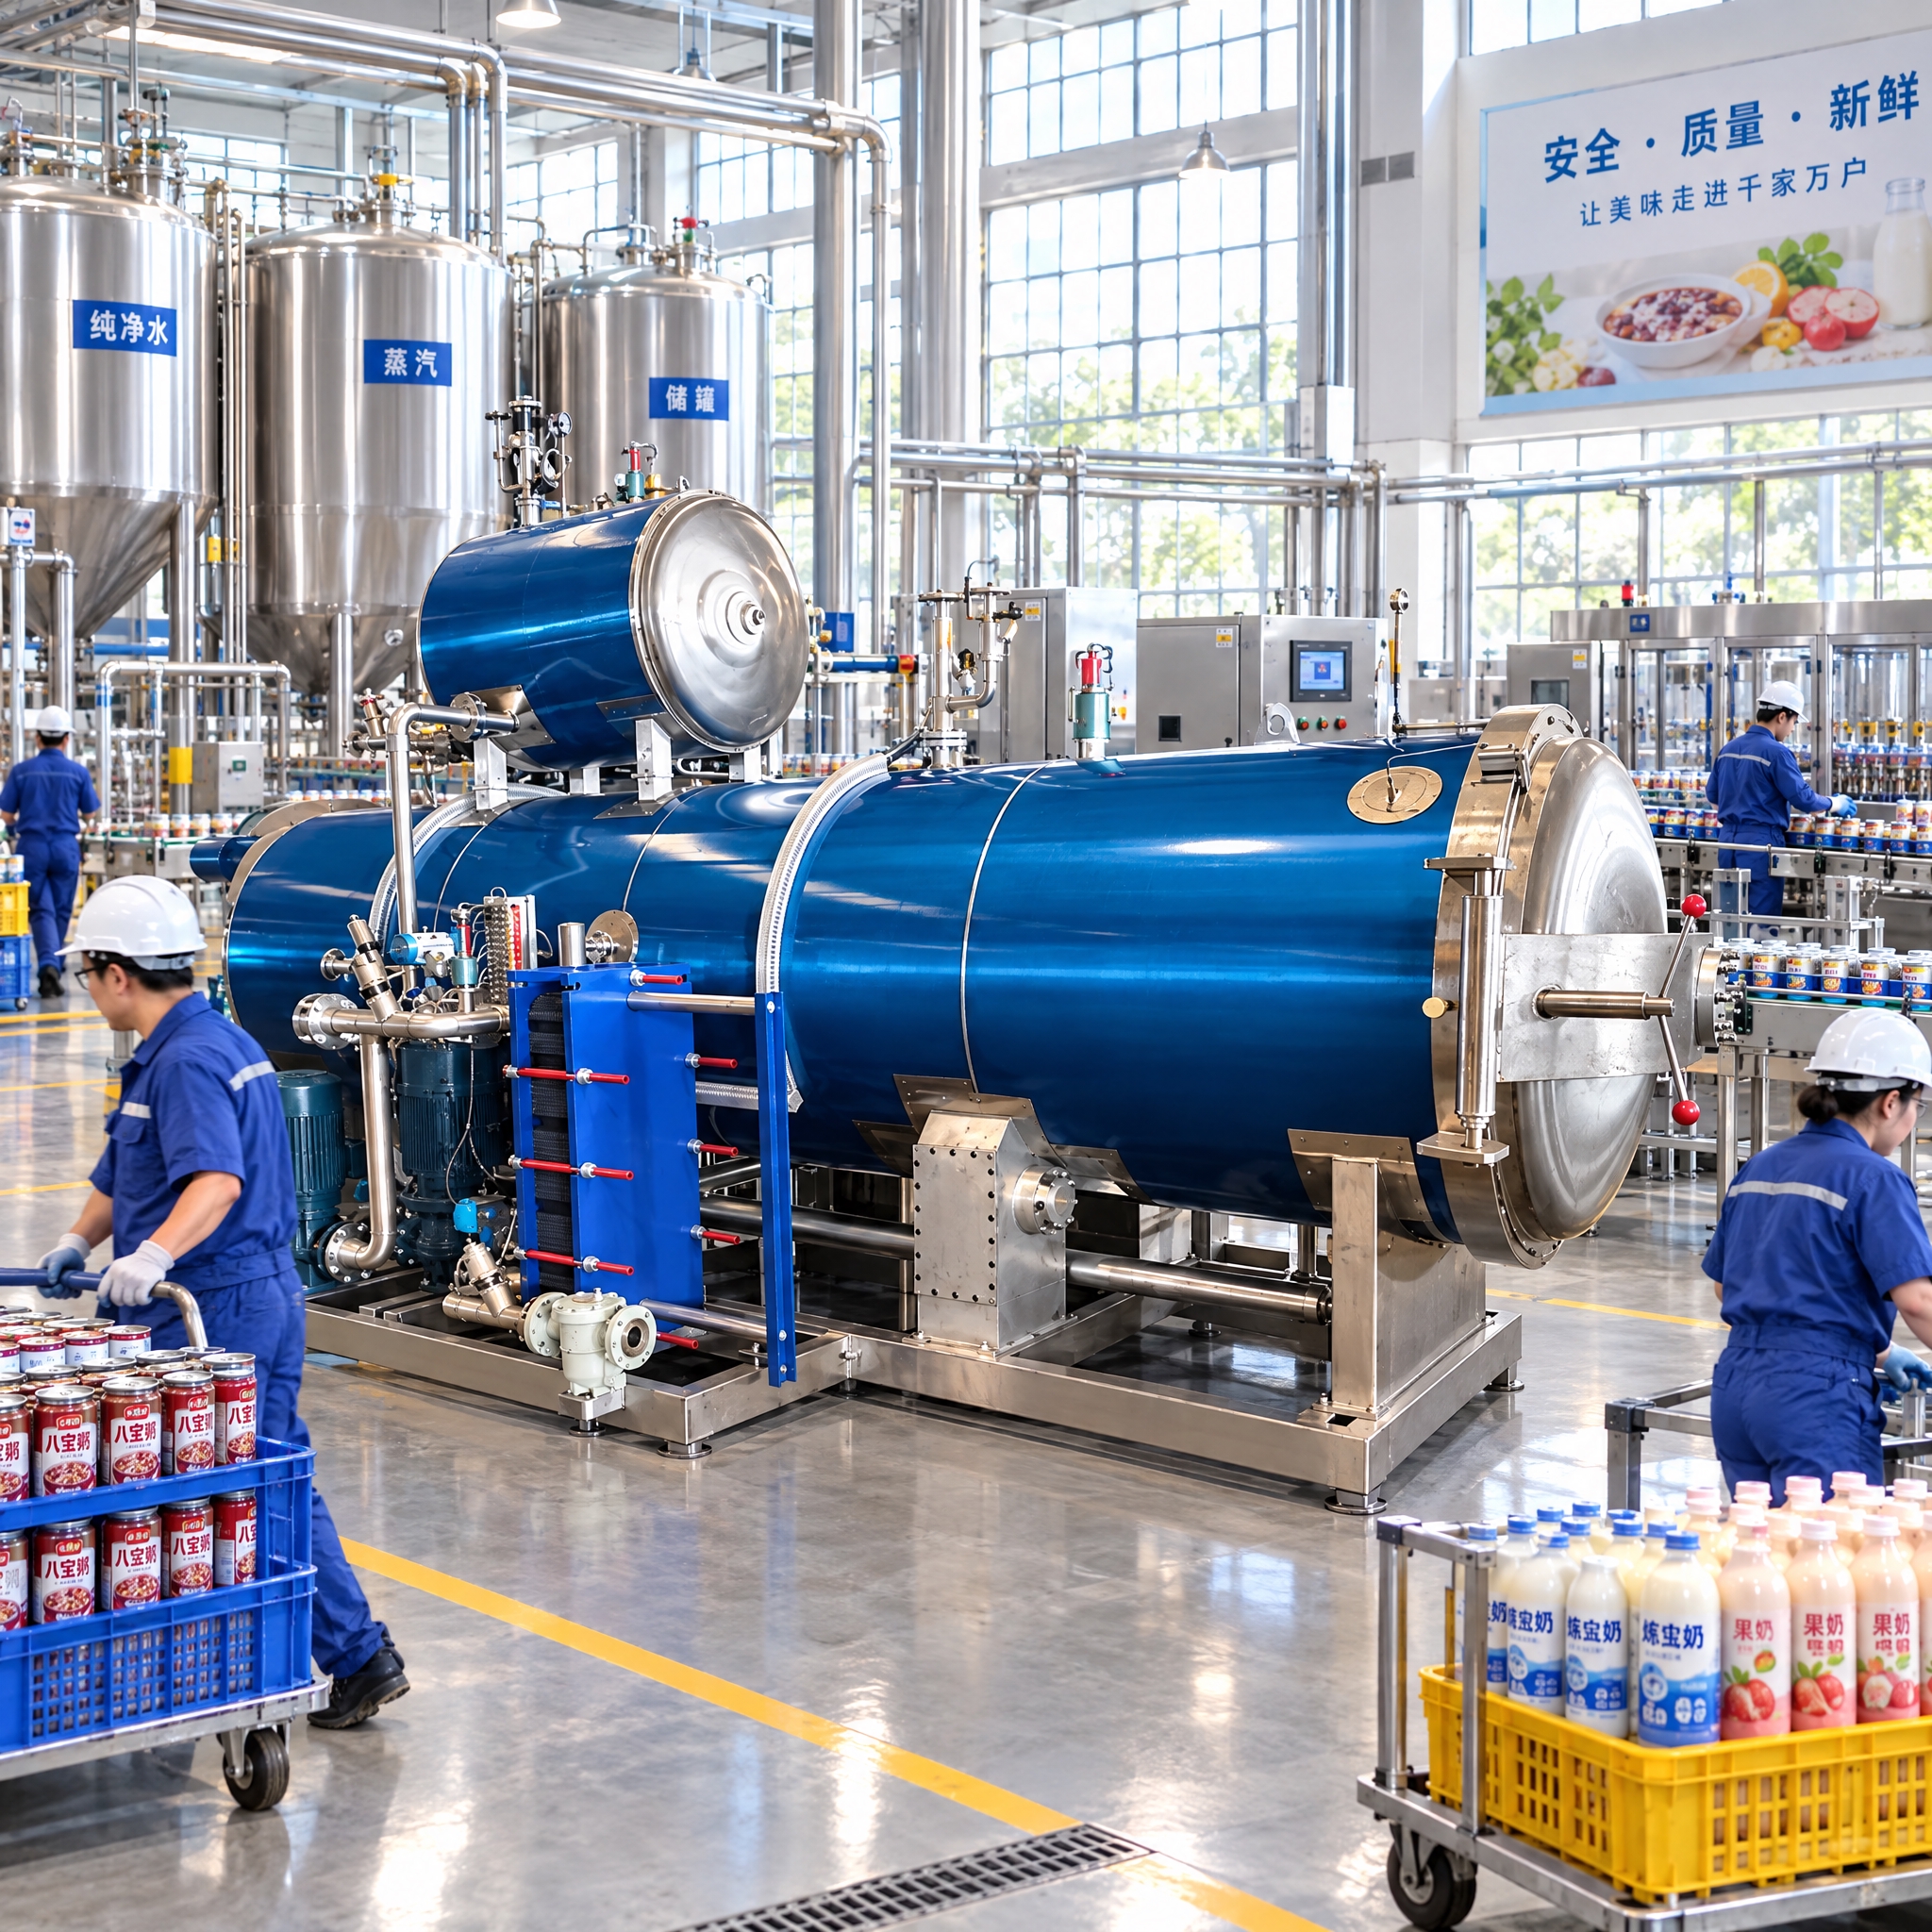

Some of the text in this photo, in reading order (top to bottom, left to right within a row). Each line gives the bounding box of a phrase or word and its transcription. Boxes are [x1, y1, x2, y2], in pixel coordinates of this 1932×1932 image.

[1544, 127, 1621, 184] 安全
[1681, 100, 1764, 158] 质量
[1829, 70, 1920, 132] 新鲜
[1579, 157, 1867, 227] 让美味走进千家万户
[90, 309, 169, 346] 纯净水
[384, 347, 438, 378] 蒸汽
[228, 1404, 257, 1425] 八宝
[45, 1431, 91, 1454] 八宝粥
[114, 1421, 157, 1444] 八宝粥
[45, 1557, 90, 1580] 八宝粥
[1733, 1618, 1774, 1641] 果奶
[1804, 1613, 1844, 1637] 果奶
[1873, 1612, 1910, 1637] 果奶
